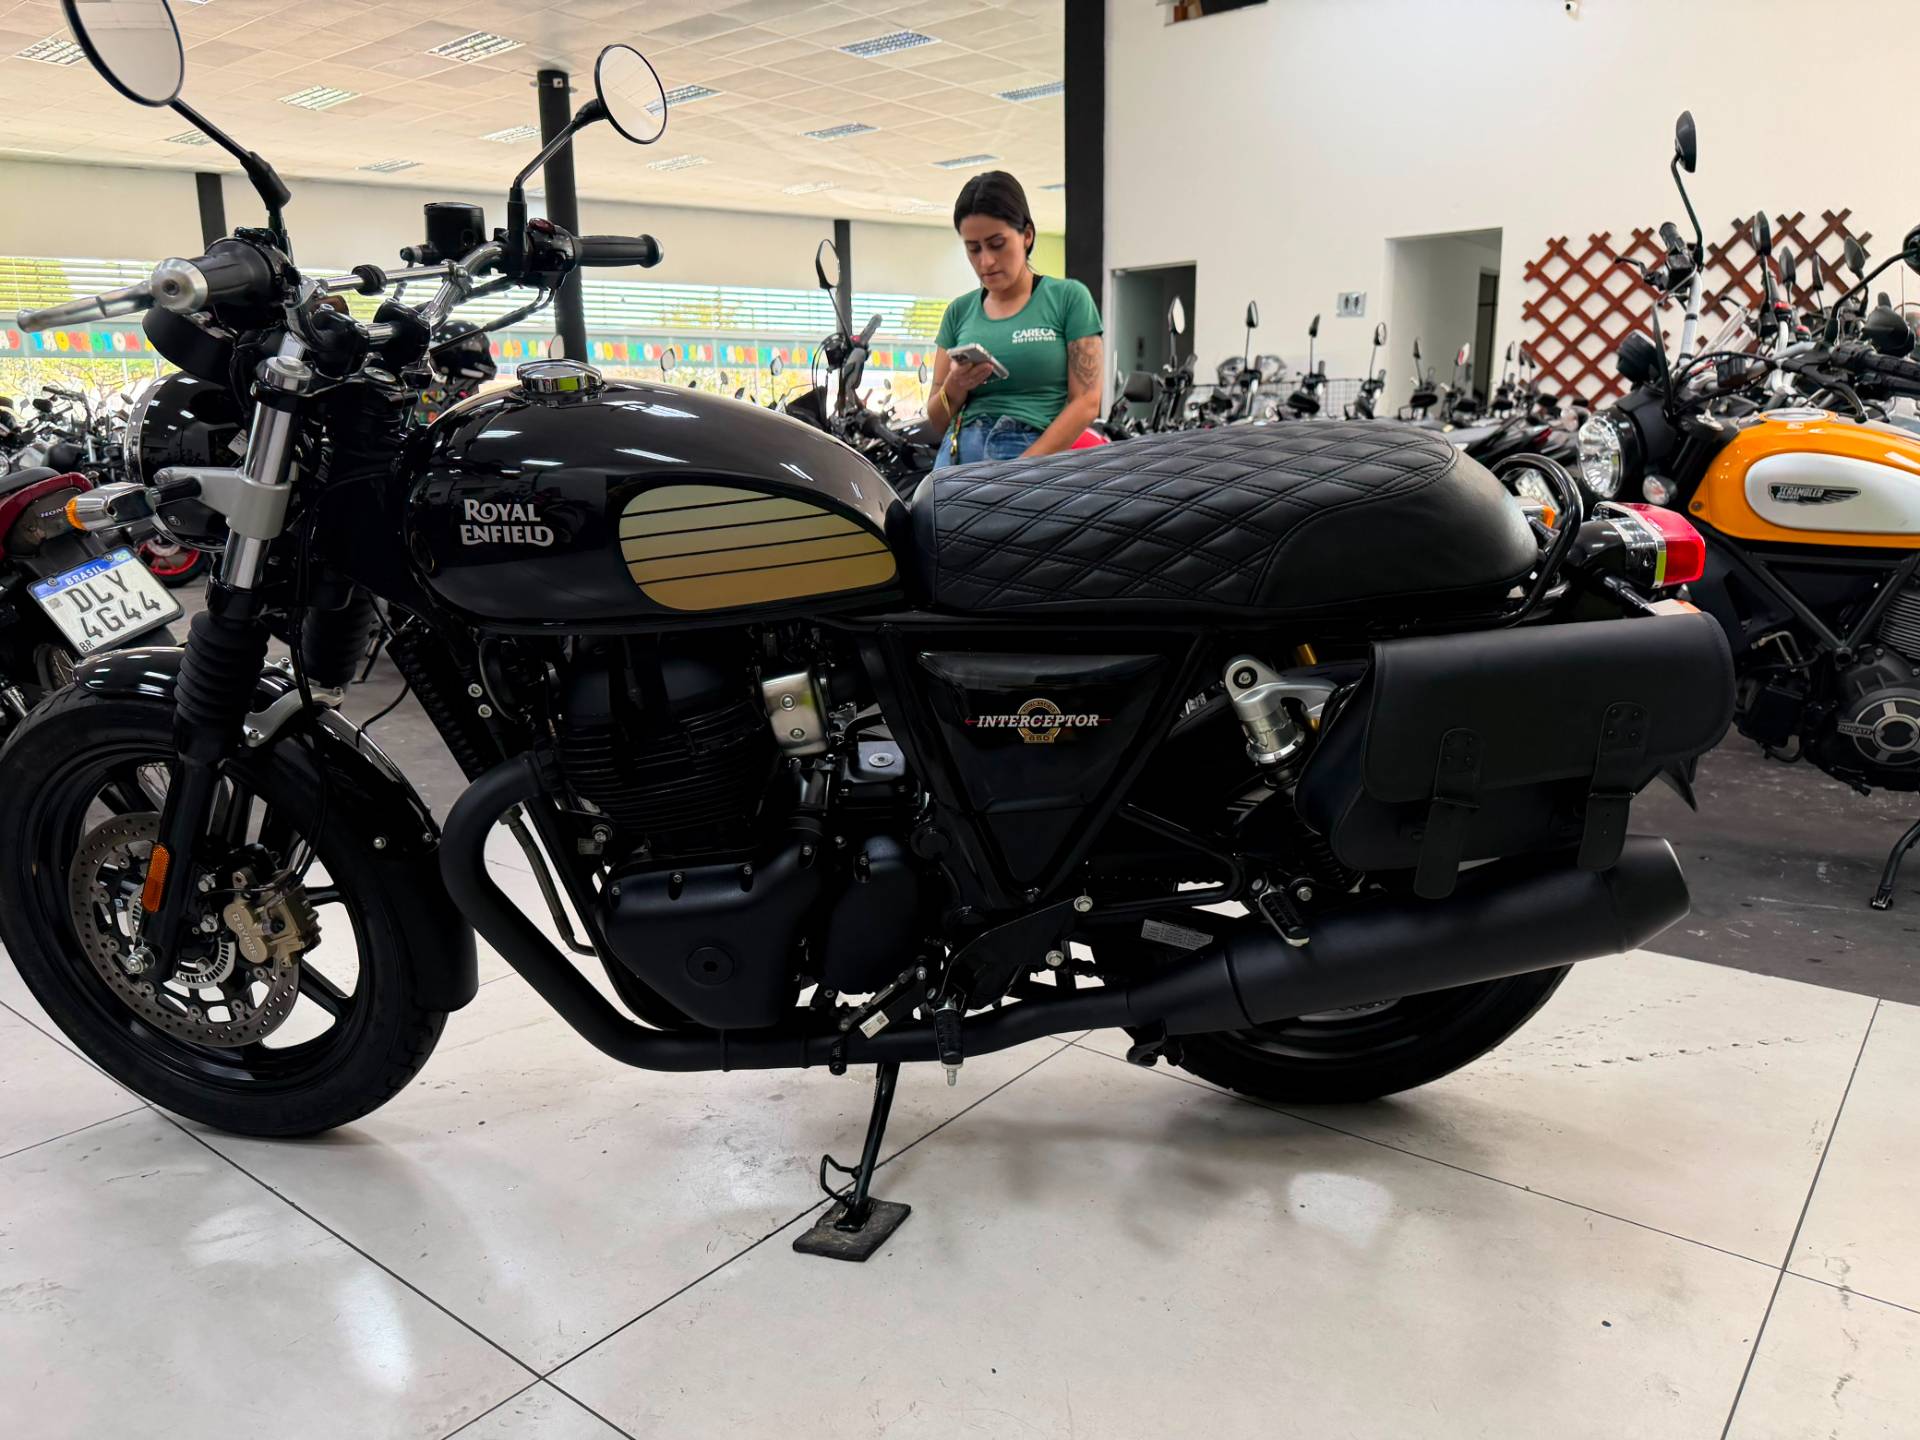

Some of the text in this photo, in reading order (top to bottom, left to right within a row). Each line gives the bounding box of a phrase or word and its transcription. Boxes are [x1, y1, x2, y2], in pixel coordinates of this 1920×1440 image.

[1012, 327, 1056, 339] CARECA
[1778, 487, 1824, 498] SCRAMBLER
[40, 507, 65, 518] HON
[463, 498, 541, 523] ROYAL
[460, 524, 554, 547] ENFIELD
[65, 565, 104, 586] BRASIL
[65, 569, 129, 613] DLY
[80, 591, 161, 638] 4G44
[79, 639, 95, 652] BR
[976, 714, 1100, 728] INTERCEPTOR
[1839, 724, 1873, 736] DUCATI
